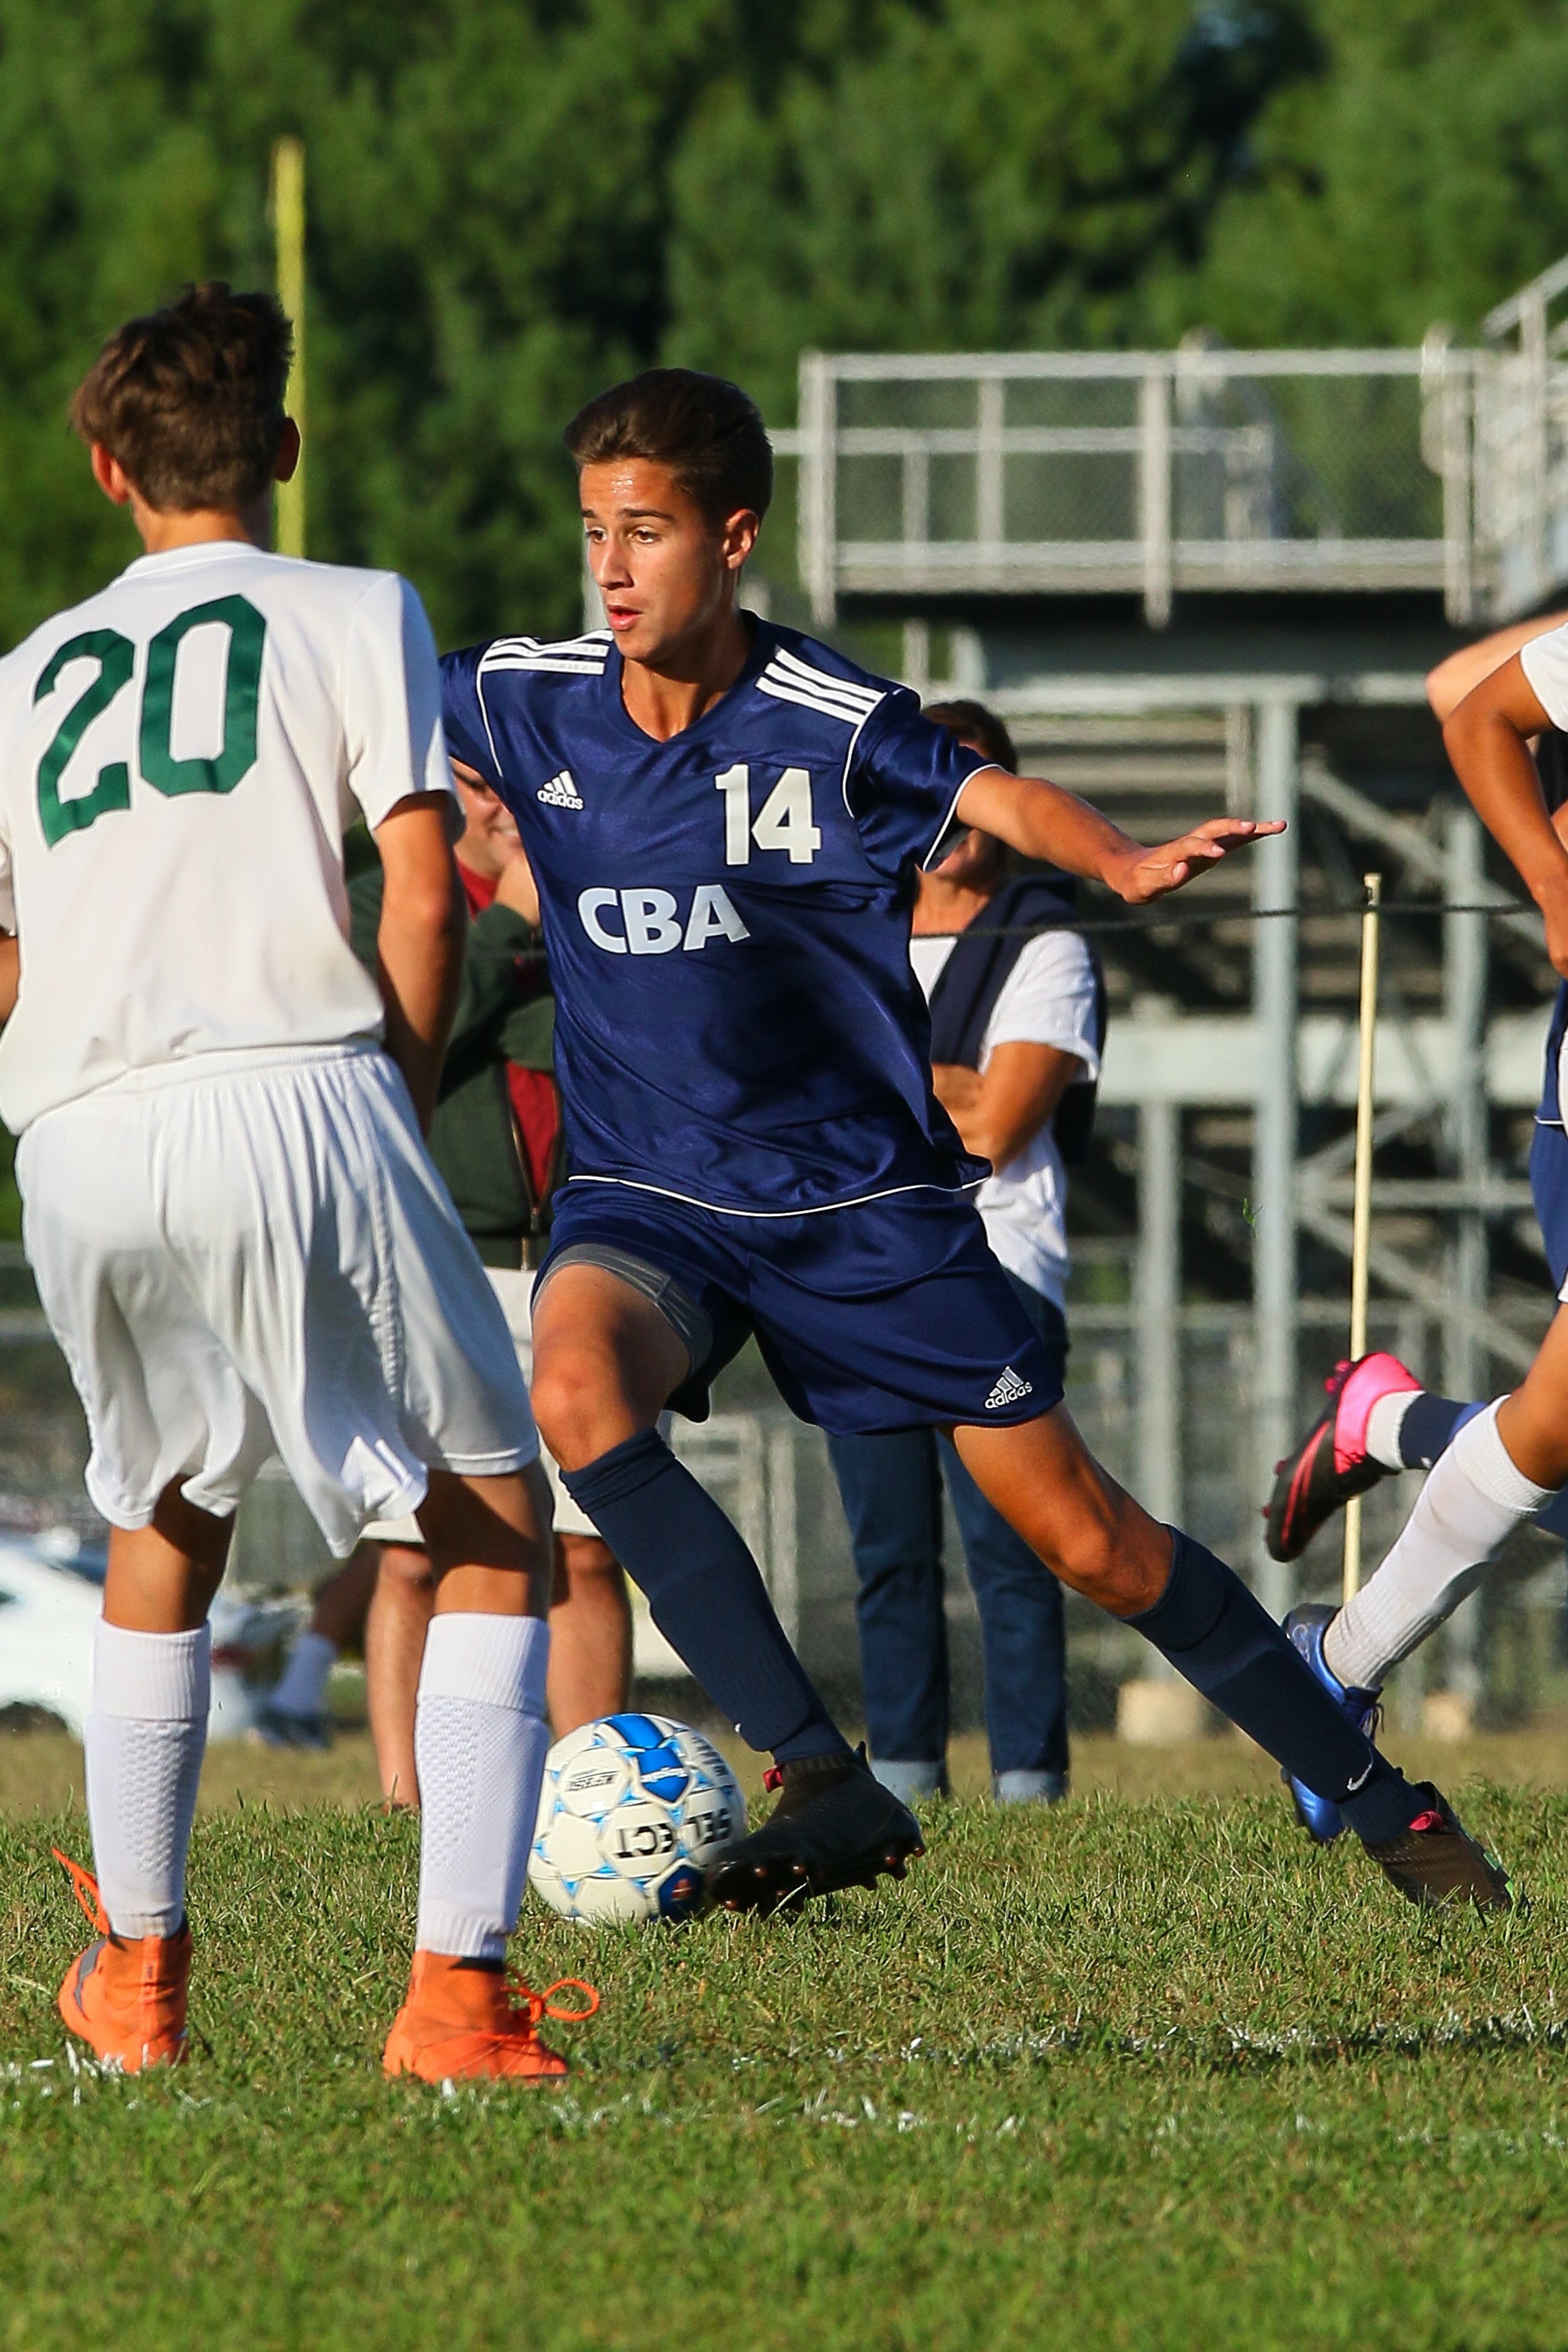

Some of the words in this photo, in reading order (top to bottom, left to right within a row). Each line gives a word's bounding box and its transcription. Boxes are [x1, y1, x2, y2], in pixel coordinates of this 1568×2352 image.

[34, 593, 266, 849] 20
[537, 788, 583, 810] adidas
[714, 763, 821, 866] 14
[577, 884, 750, 955] CBA
[985, 1382, 1033, 1409] adidas
